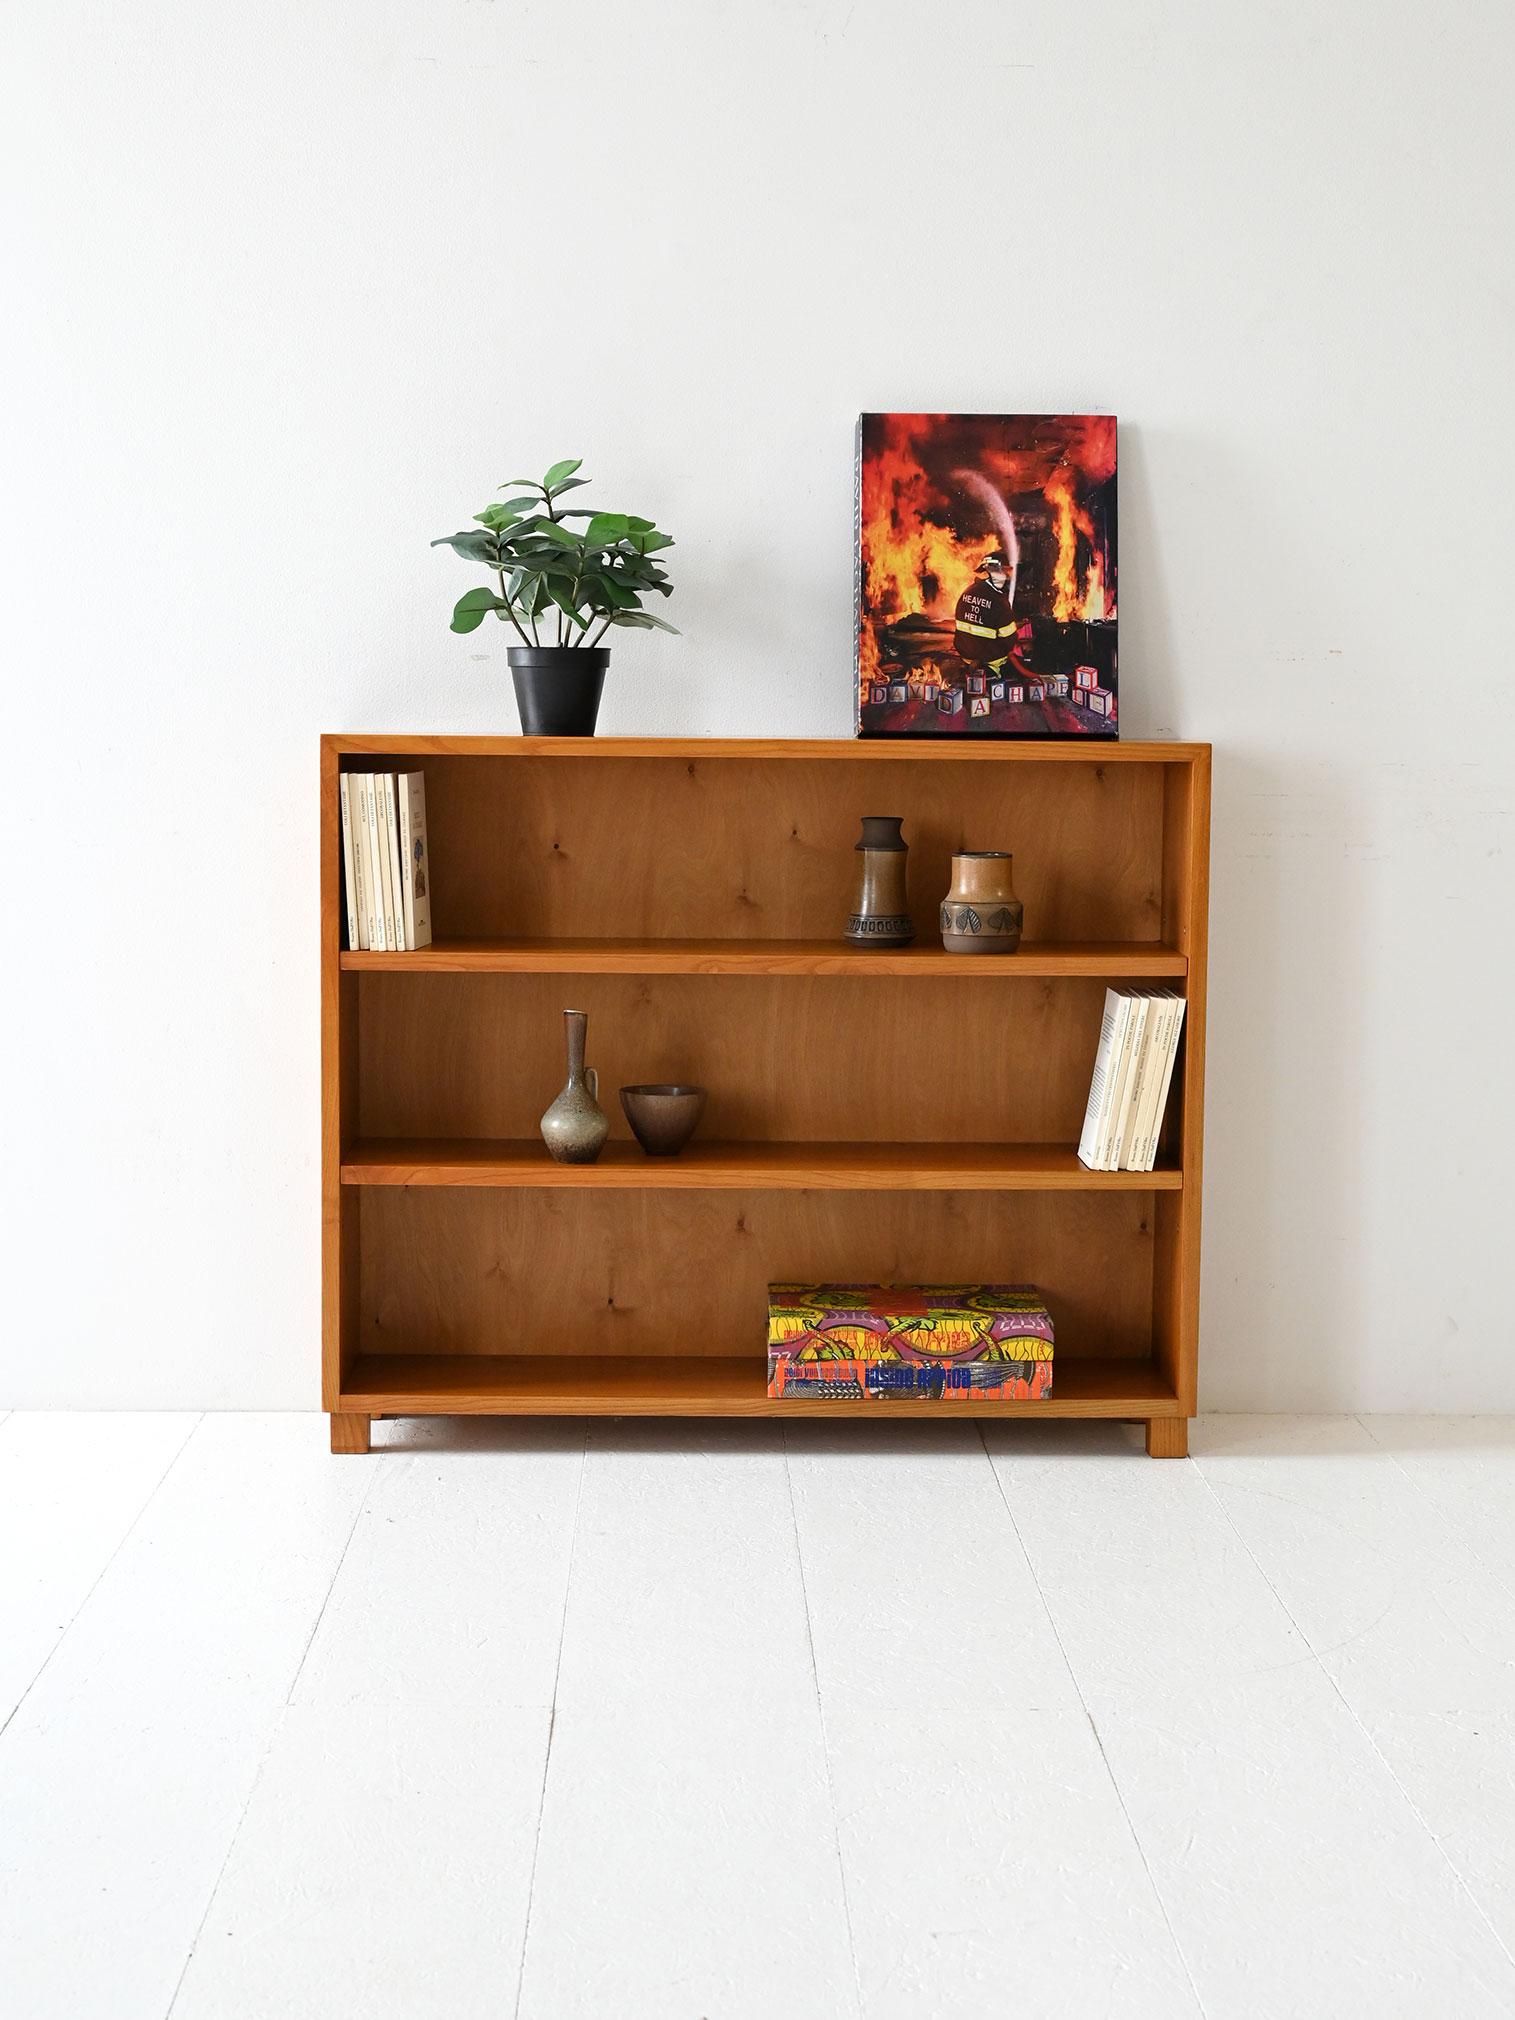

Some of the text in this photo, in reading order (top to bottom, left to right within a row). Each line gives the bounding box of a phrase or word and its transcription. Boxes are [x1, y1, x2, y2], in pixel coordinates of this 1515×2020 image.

[962, 594, 992, 609] HEAVEN
[971, 605, 980, 614] TO
[964, 612, 984, 625] HELL
[872, 685, 953, 712] DAVID
